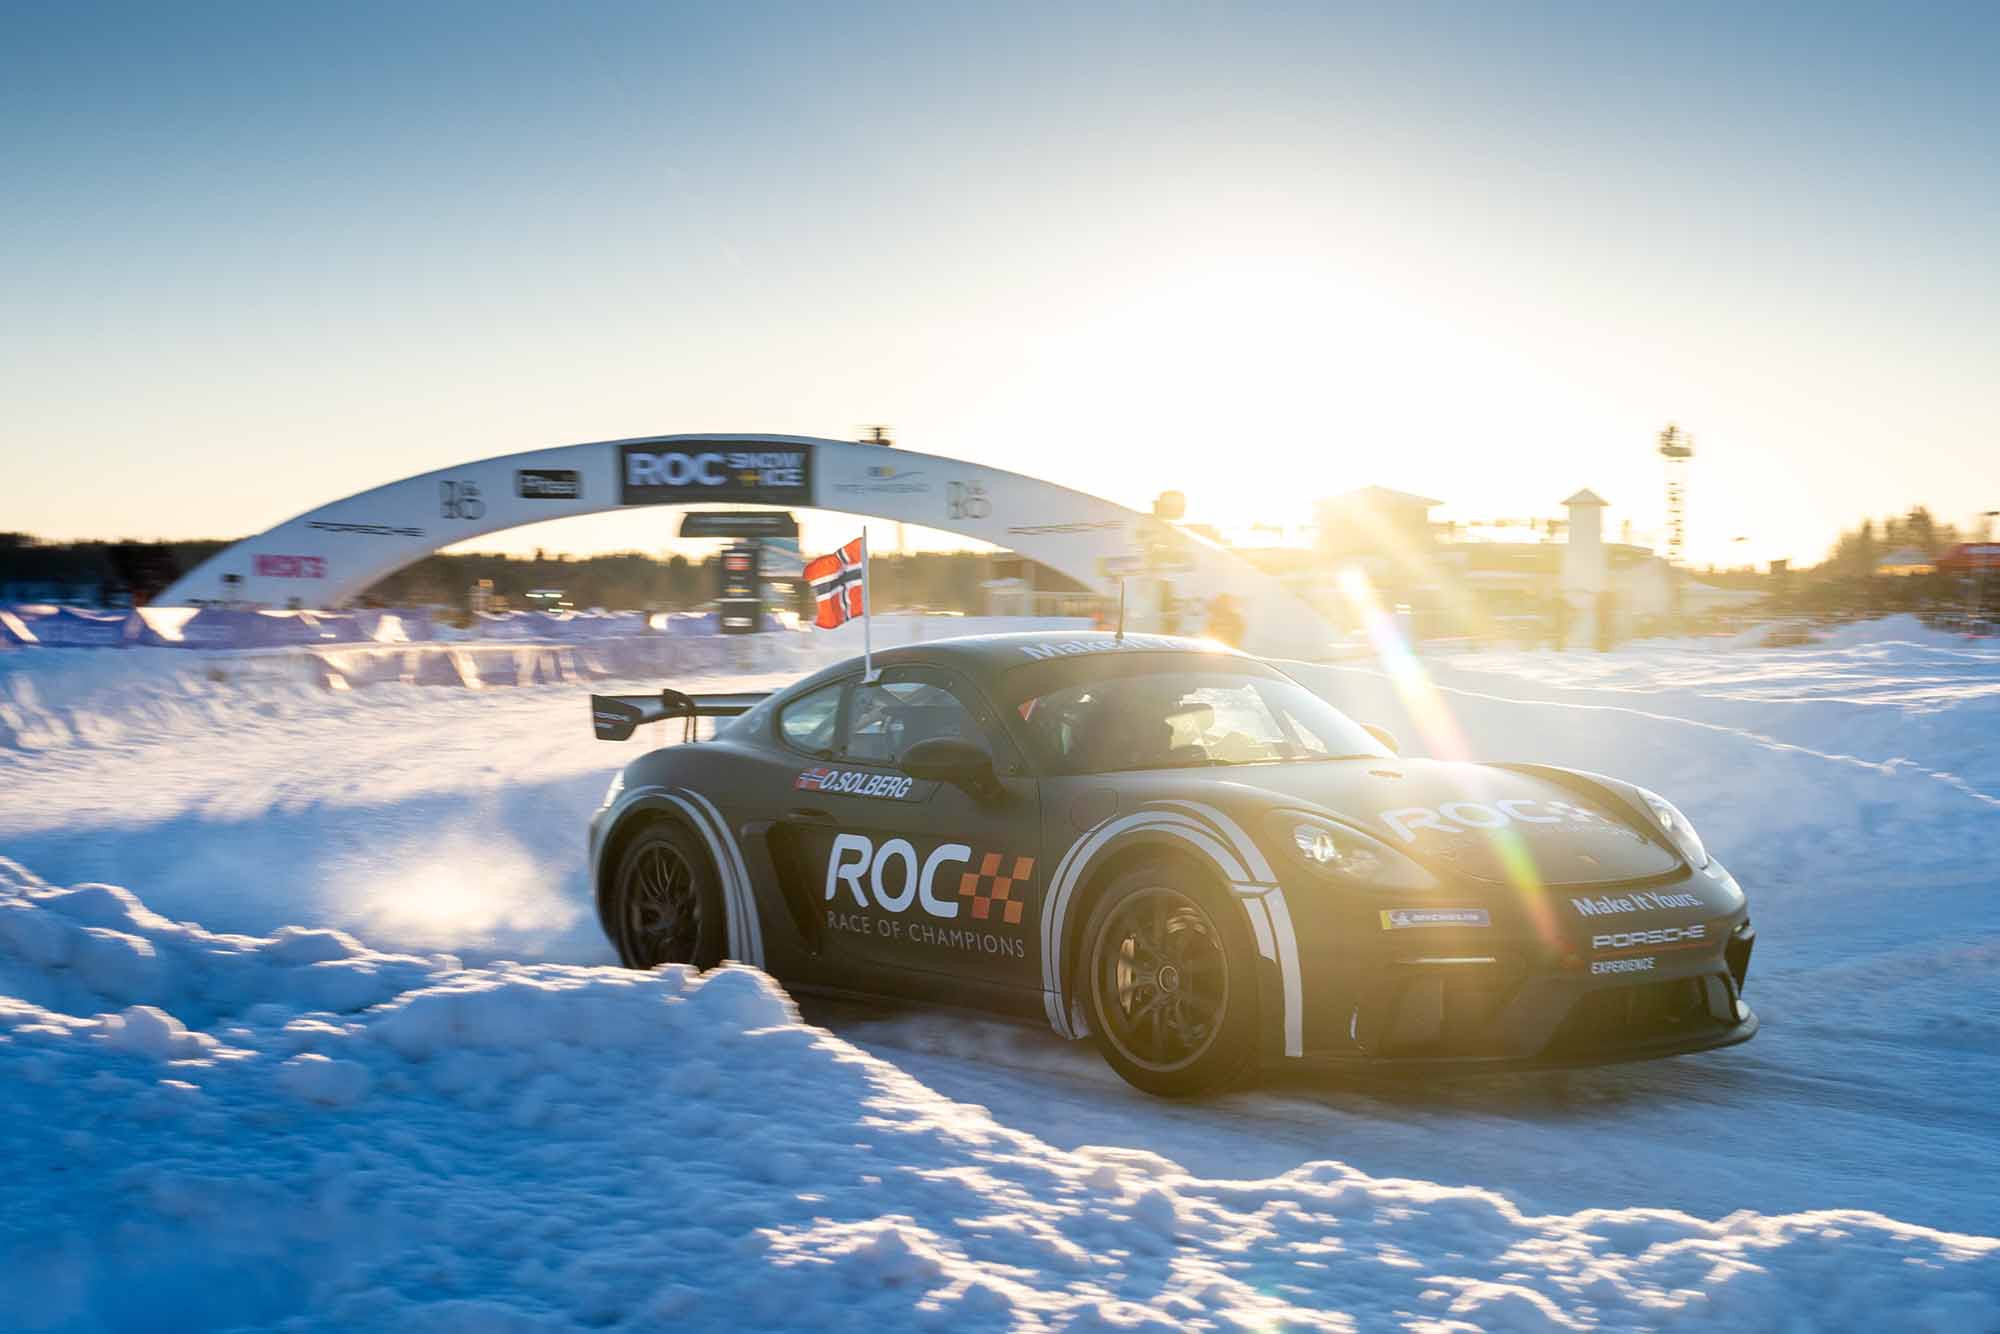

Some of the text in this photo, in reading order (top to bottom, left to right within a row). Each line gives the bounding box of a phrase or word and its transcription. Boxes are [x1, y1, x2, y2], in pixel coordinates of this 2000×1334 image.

[627, 452, 728, 486] ROC
[820, 771, 912, 798] O.SOLBERG
[1379, 799, 1560, 842] ROC
[825, 833, 972, 918] ROC
[1571, 896, 1635, 917] Make
[1628, 893, 1655, 911] It
[827, 911, 1025, 958] RACE OF CHAMPIONS
[1592, 925, 1705, 949] PORSCHE
[1591, 957, 1656, 975] EXPERIENCE
